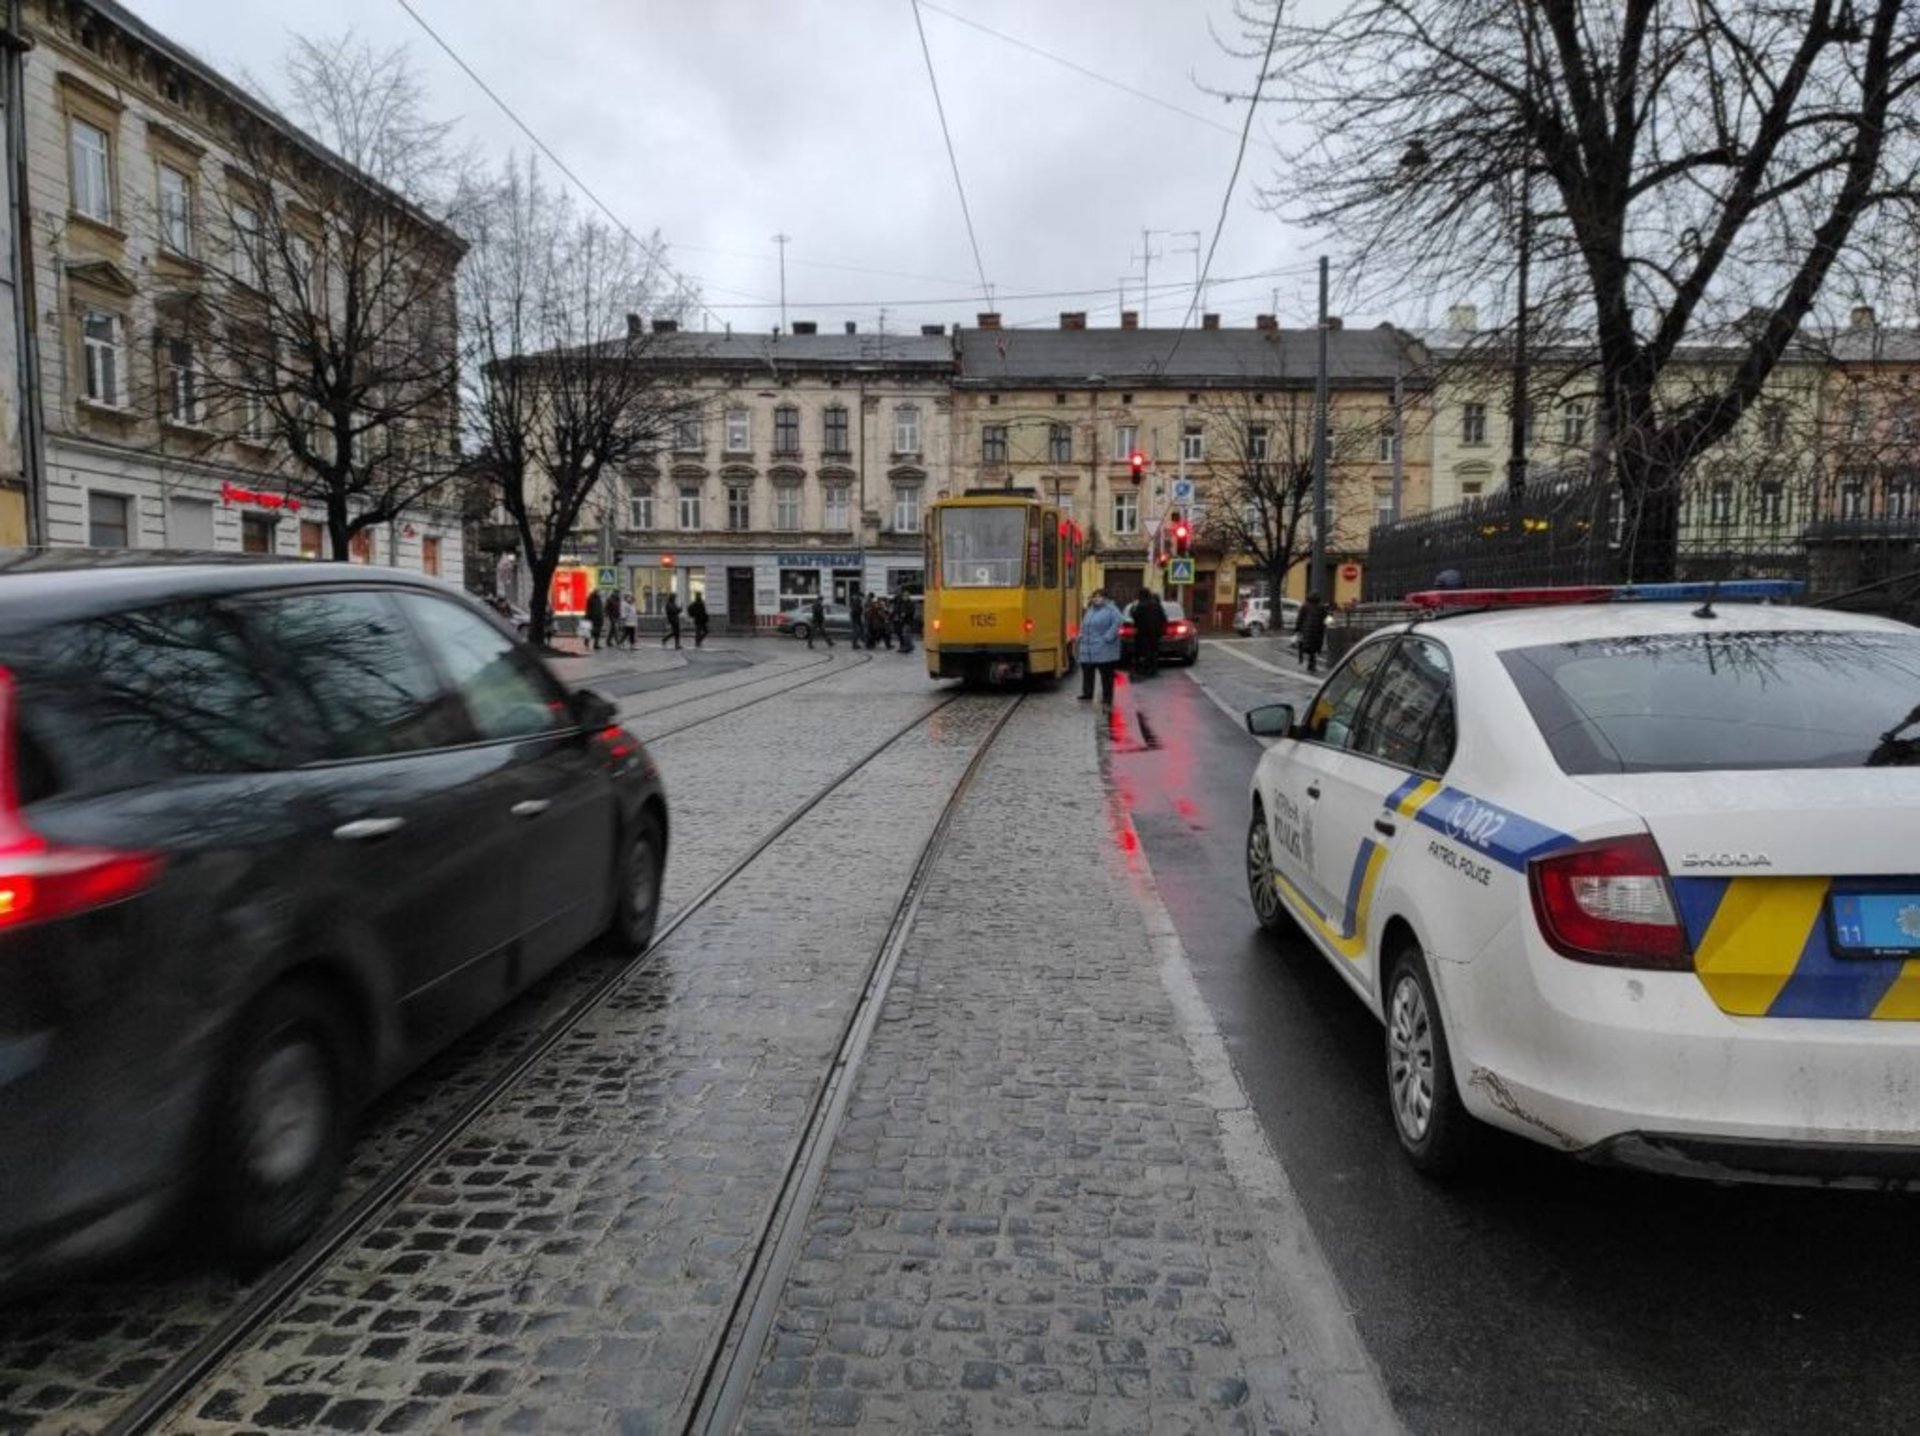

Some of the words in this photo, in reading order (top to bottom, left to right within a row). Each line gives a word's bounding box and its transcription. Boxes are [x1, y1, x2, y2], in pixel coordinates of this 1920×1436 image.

[976, 568, 989, 585] 9
[1464, 806, 1507, 848] 102
[1427, 840, 1458, 870] PATROL
[1458, 856, 1493, 887] POLICE
[1840, 925, 1862, 943] 11
